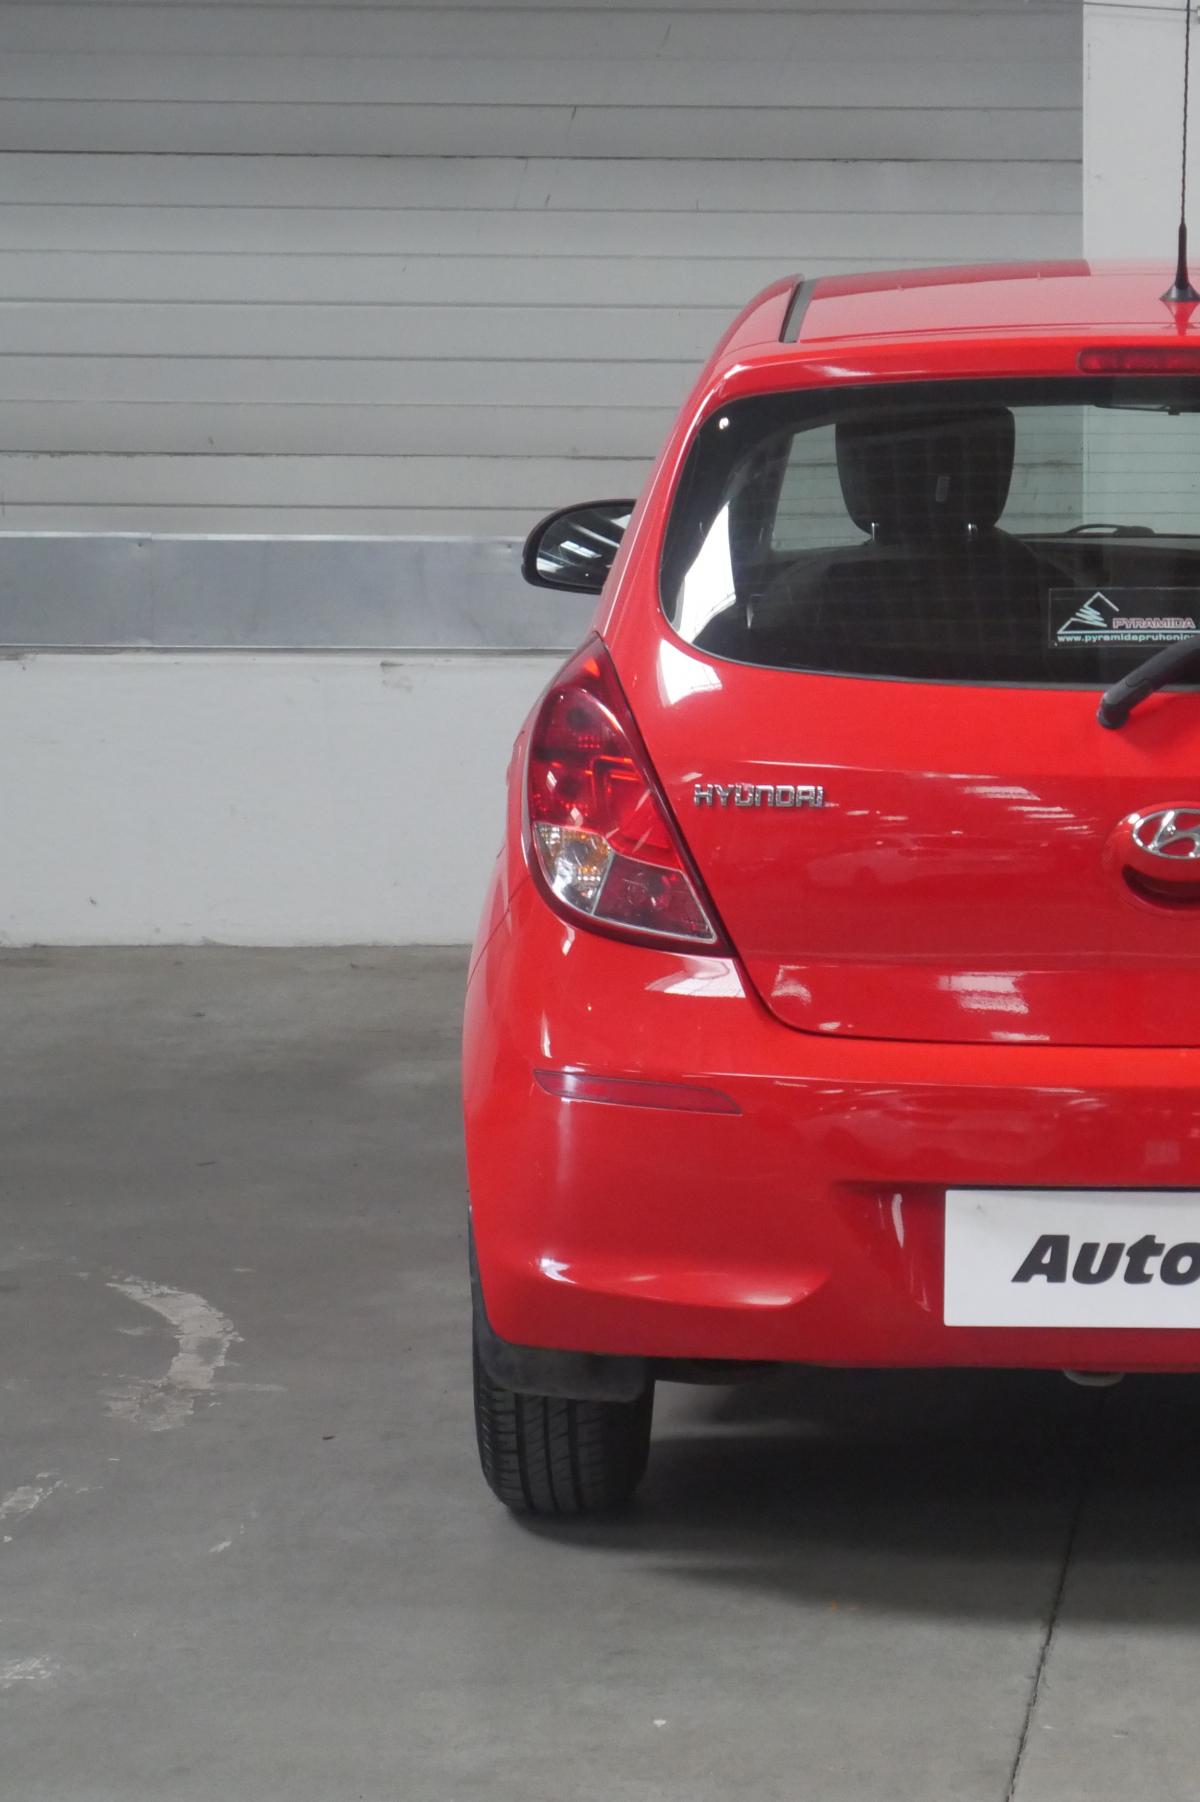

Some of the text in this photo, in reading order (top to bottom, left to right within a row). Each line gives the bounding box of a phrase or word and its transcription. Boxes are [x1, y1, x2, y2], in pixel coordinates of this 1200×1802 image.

[1112, 617, 1196, 629] PYRAMIDA
[1057, 632, 1194, 642] www.pyramidapruhonic
[694, 784, 823, 807] HYUNDAI
